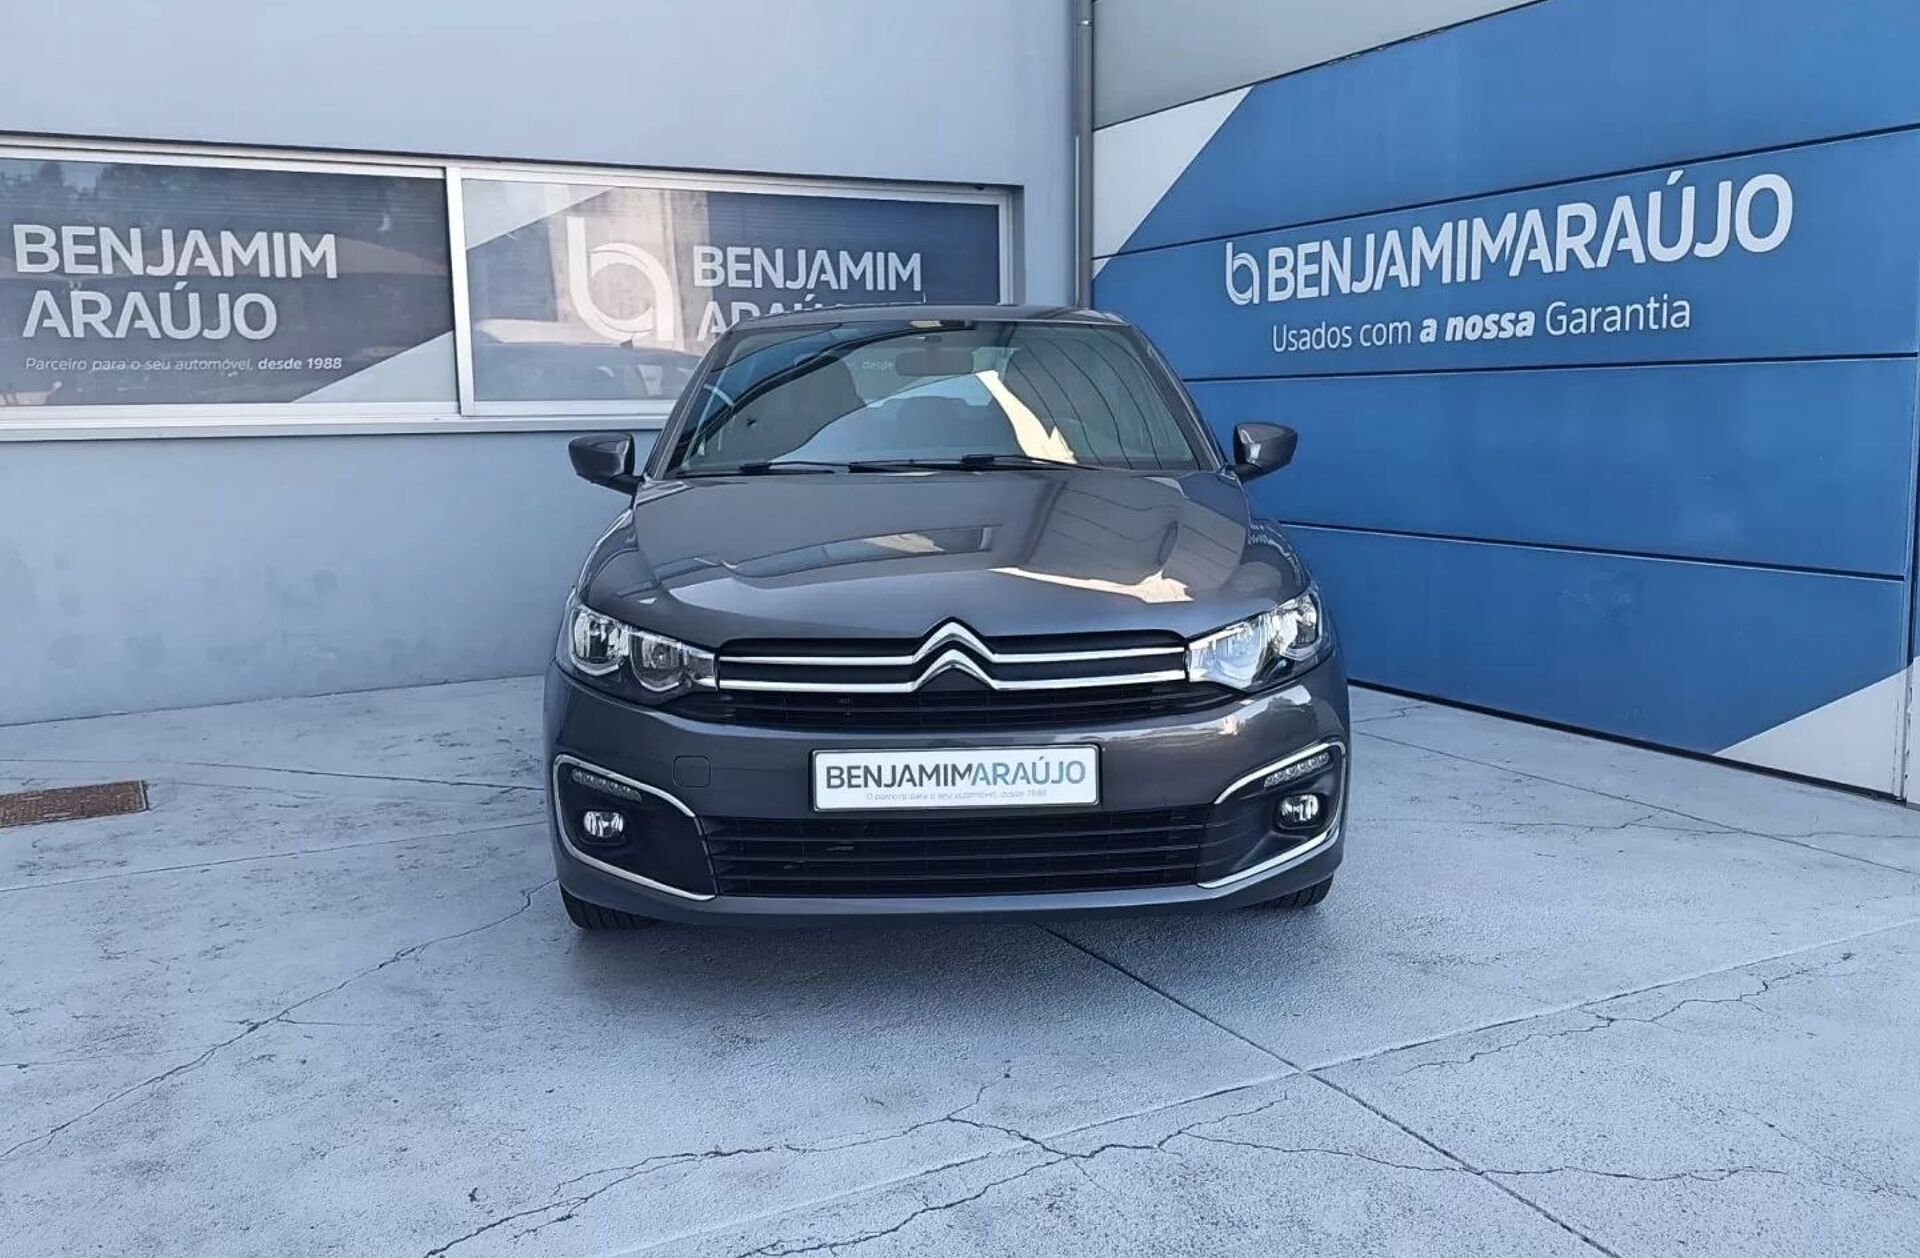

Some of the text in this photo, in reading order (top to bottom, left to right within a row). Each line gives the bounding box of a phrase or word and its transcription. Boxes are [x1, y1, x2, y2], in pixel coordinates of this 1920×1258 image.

[13, 223, 339, 279] BENJAMIM
[1267, 170, 1794, 302] BENJAMIMARAÚJO
[692, 245, 923, 292] BENJAMIM
[22, 281, 278, 340] ARAÚJO
[1273, 293, 1691, 352] Usados com a nossa Garantia
[25, 356, 343, 372] Parceiro para o seu automóvel, desde 1988
[825, 756, 1087, 789] BENJAMIMARAÚJO
